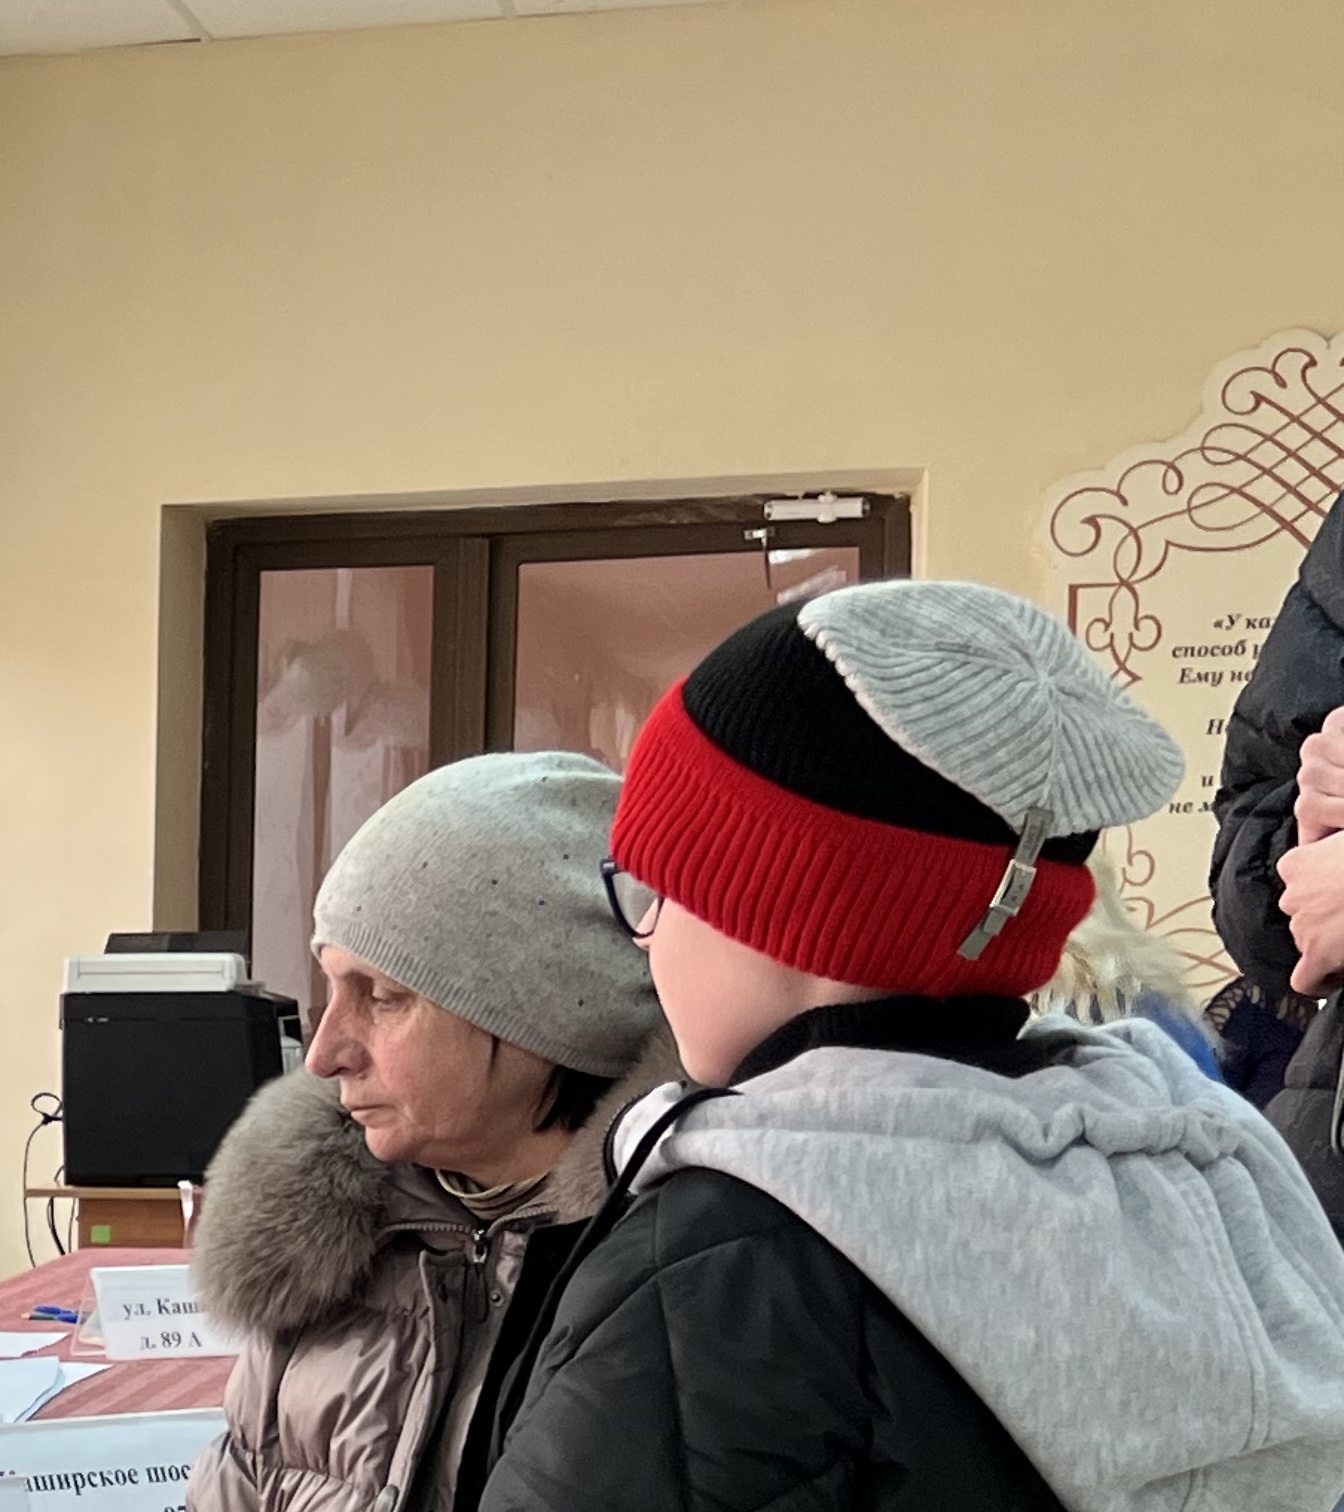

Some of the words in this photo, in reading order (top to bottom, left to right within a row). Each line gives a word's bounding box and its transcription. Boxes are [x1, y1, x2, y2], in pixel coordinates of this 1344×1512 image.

[1171, 639, 1247, 659] способ
[1178, 667, 1224, 687] Ему
[122, 1303, 152, 1321] ул.
[160, 1331, 182, 1349] 89
[145, 1464, 191, 1483] шос
